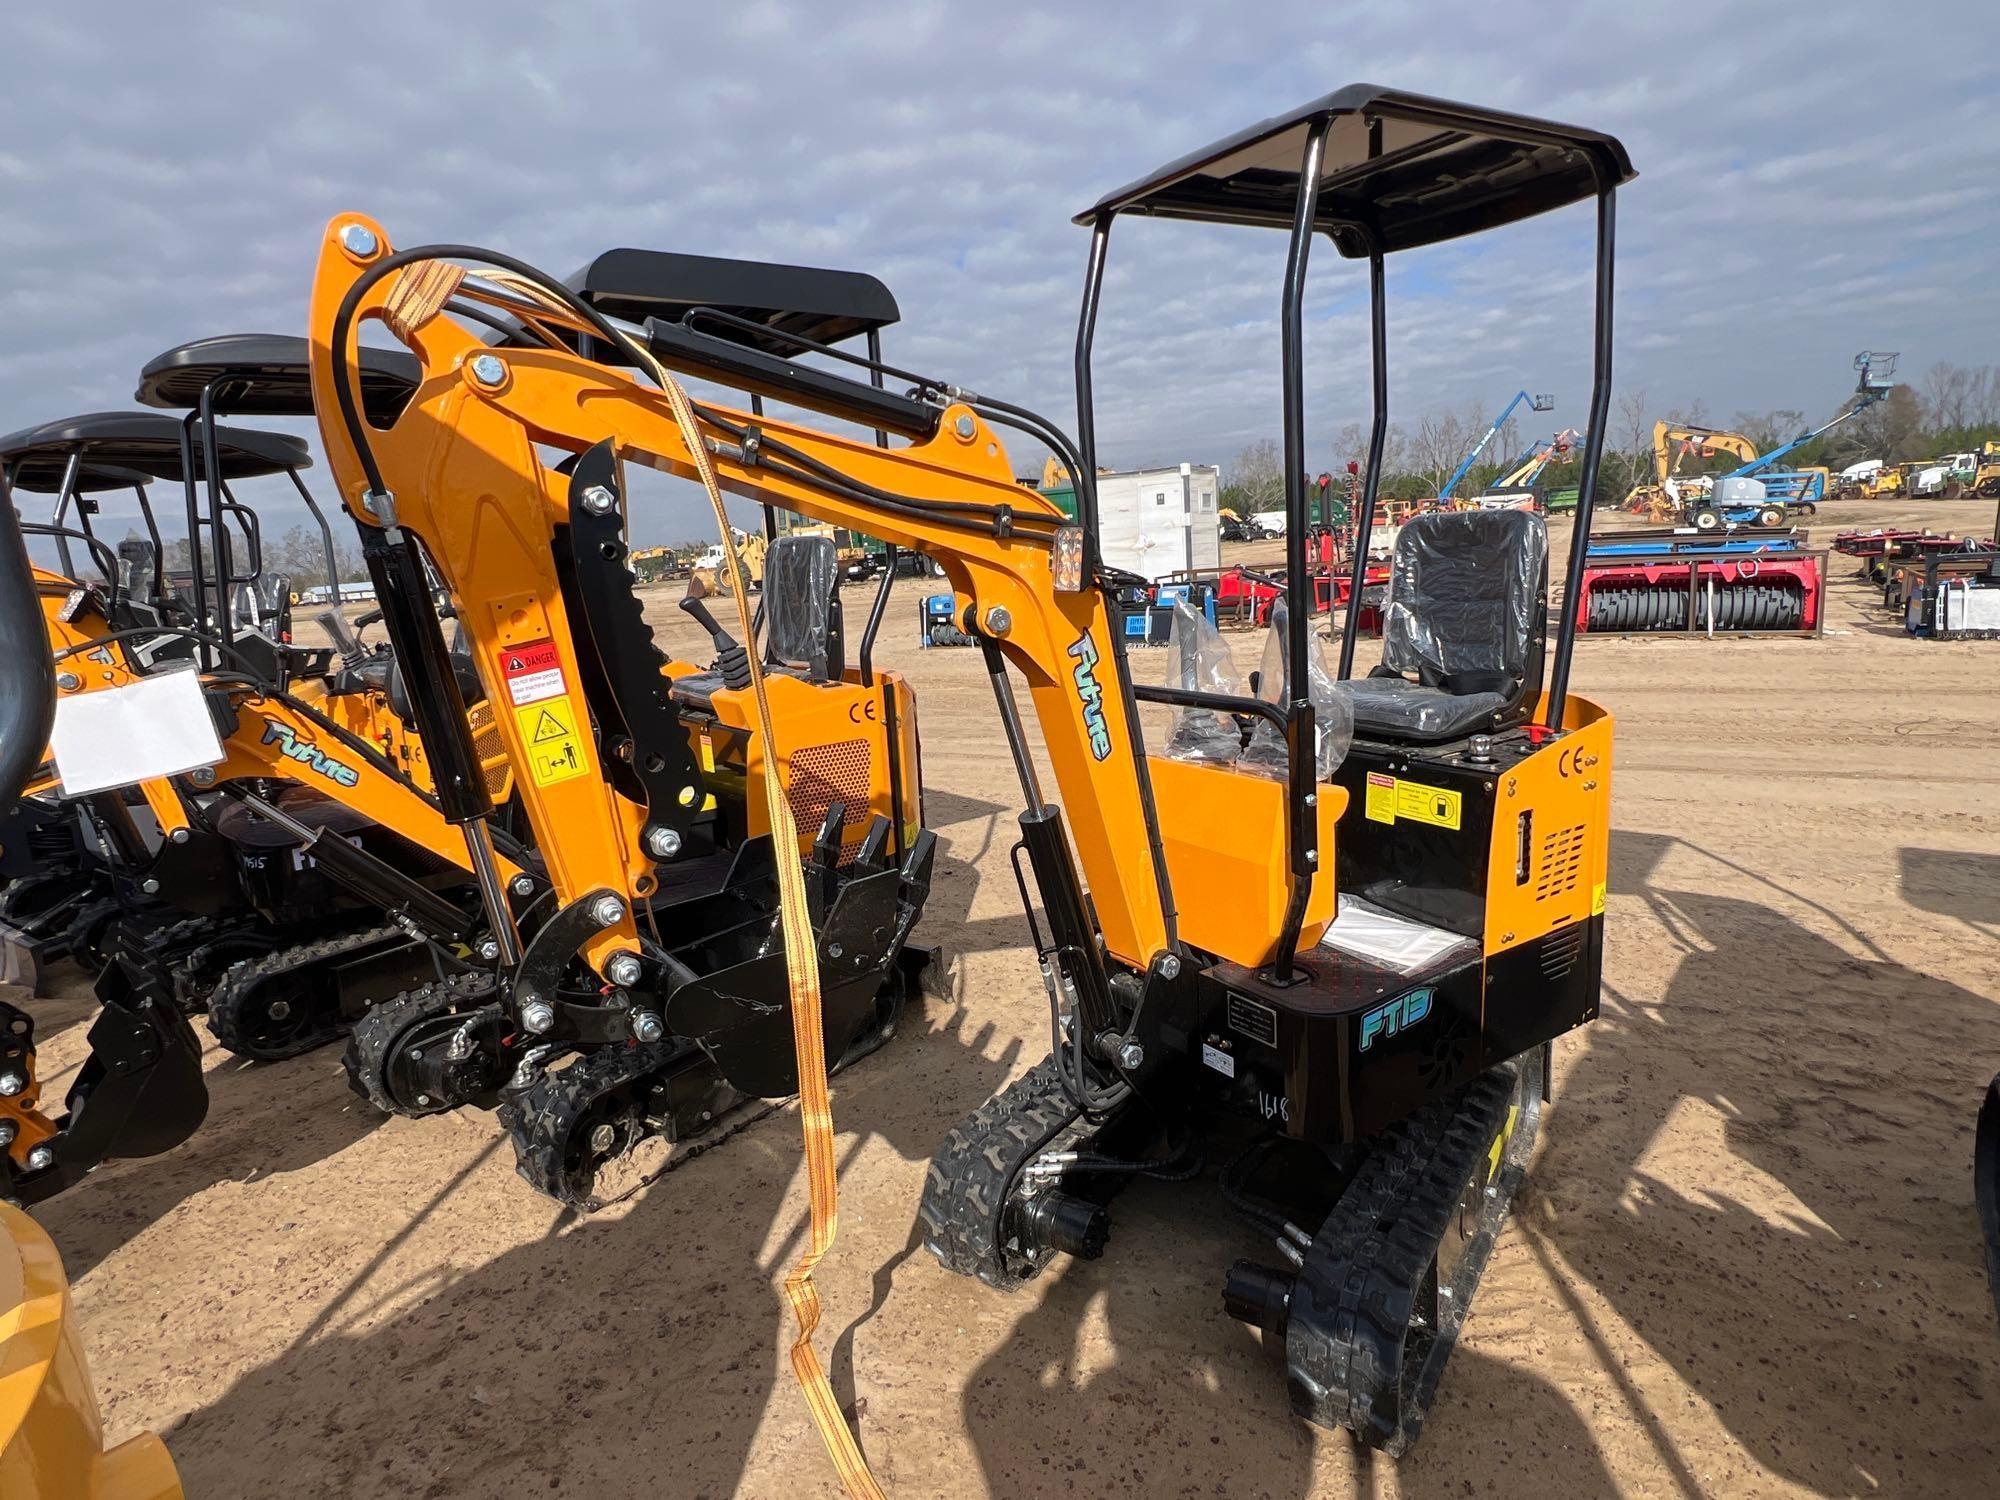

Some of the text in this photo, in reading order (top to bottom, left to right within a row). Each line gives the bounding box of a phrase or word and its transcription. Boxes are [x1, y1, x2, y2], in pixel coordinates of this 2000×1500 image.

[525, 652, 555, 667] DANGER
[525, 682, 546, 691] machine
[529, 675, 542, 683] allow
[542, 671, 559, 680] people
[1067, 626, 1112, 762] Future
[849, 699, 876, 724] CE
[261, 718, 360, 788] Future
[1559, 745, 1584, 778] CE
[1259, 1090, 1289, 1122] 1618
